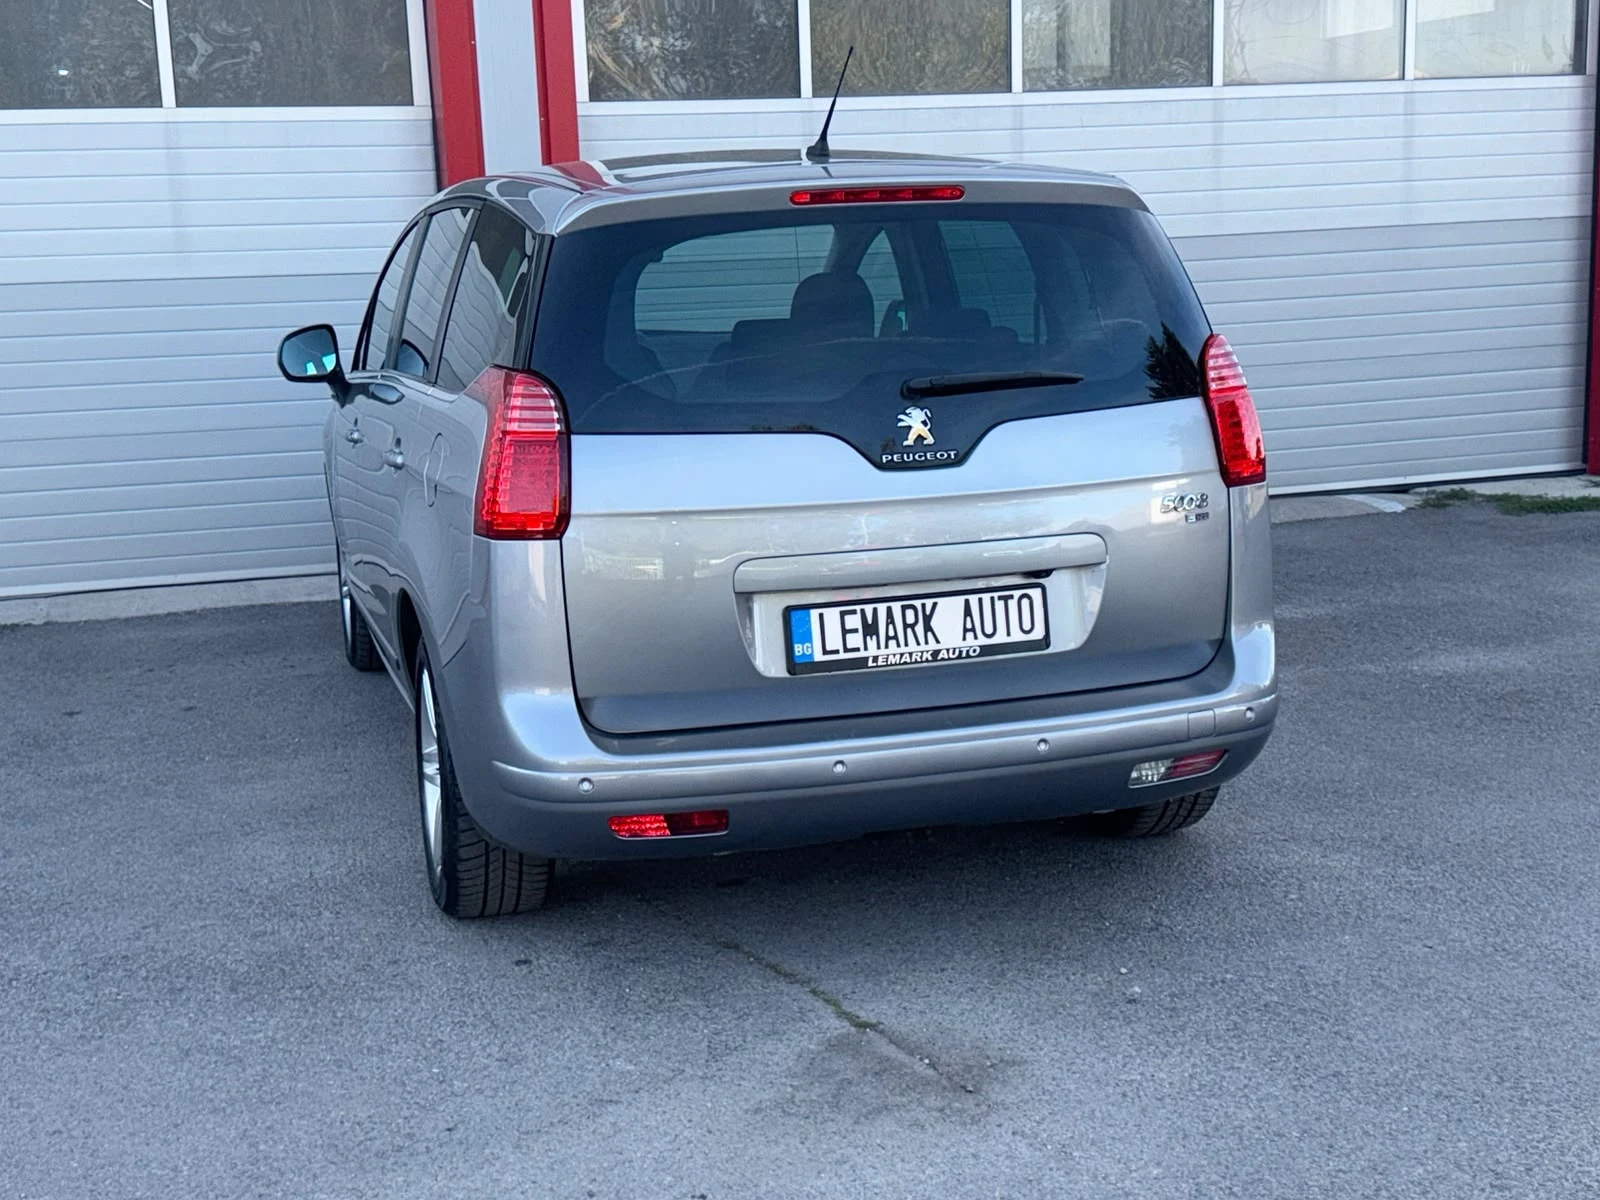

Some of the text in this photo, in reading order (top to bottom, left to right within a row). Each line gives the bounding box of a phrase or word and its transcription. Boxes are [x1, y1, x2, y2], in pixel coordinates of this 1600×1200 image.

[882, 451, 957, 463] PEUGEOT
[1160, 492, 1209, 513] 5008
[818, 593, 1035, 656] LEMARK AUTO
[794, 642, 812, 656] BG
[867, 645, 980, 667] LEMARK AUTO
